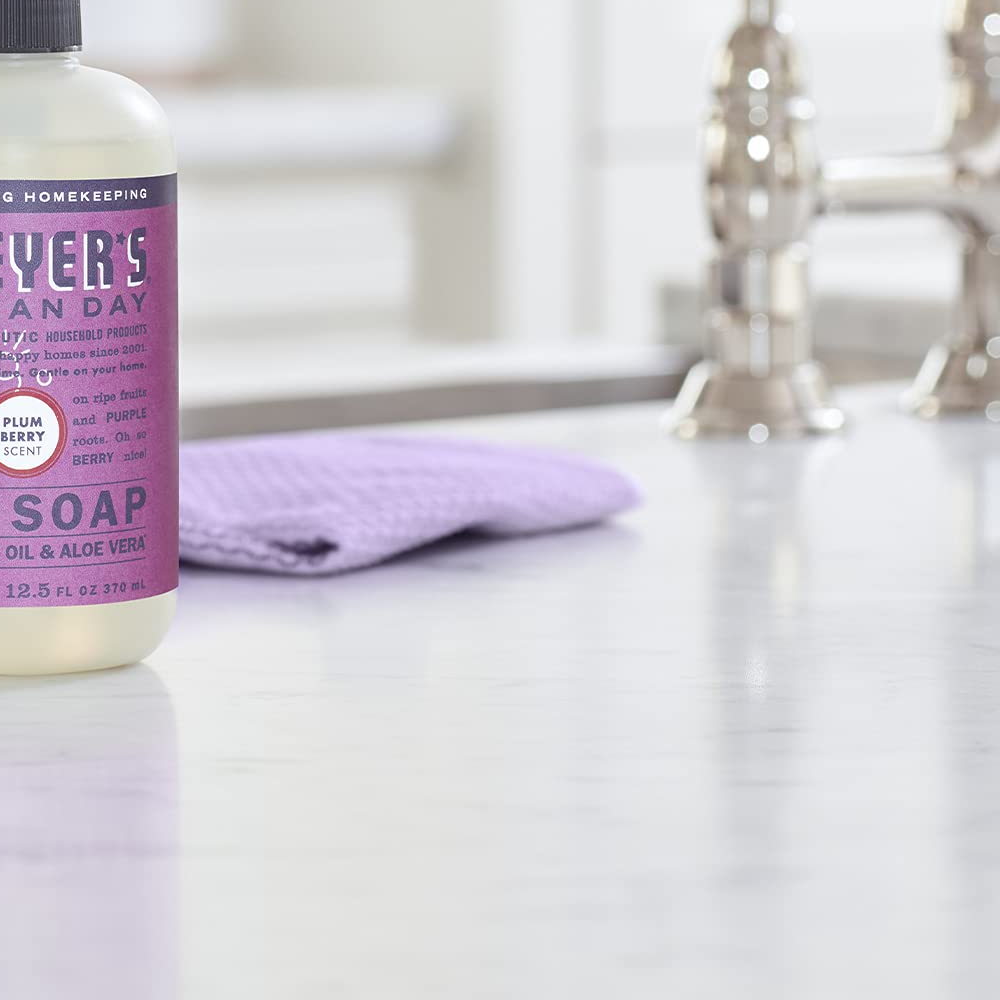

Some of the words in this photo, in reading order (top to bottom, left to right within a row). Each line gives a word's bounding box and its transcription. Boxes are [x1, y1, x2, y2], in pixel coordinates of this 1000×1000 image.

[24, 188, 147, 203] HOMEKEEPING
[83, 292, 147, 318] DAY
[46, 328, 103, 342] HOUSEHOLD
[107, 323, 147, 339] PRODUCTS
[43, 349, 86, 360] homes
[89, 347, 119, 358] since
[29, 367, 69, 377] Gentle
[73, 367, 88, 376] on
[92, 366, 116, 378] your
[120, 361, 147, 373] home.
[72, 395, 89, 405] on
[93, 391, 116, 405] ripe
[120, 388, 147, 401] fruits
[3, 416, 43, 428] PLUM
[72, 414, 96, 426] and
[106, 407, 147, 423] PURPLE
[0, 431, 45, 443] BERRY
[72, 436, 109, 447] roots.
[115, 431, 130, 443] Oh
[136, 430, 147, 440] so
[3, 446, 42, 457] SCENT
[72, 451, 114, 466] BERRY
[11, 486, 147, 532] SOAP
[5, 545, 34, 560] OIL
[40, 543, 55, 559] &
[59, 540, 104, 558] ALOE
[6, 582, 50, 599] 12.5
[57, 586, 73, 598] FL
[80, 584, 97, 597] OZ
[103, 582, 127, 595] 370
[131, 578, 147, 591] mL
